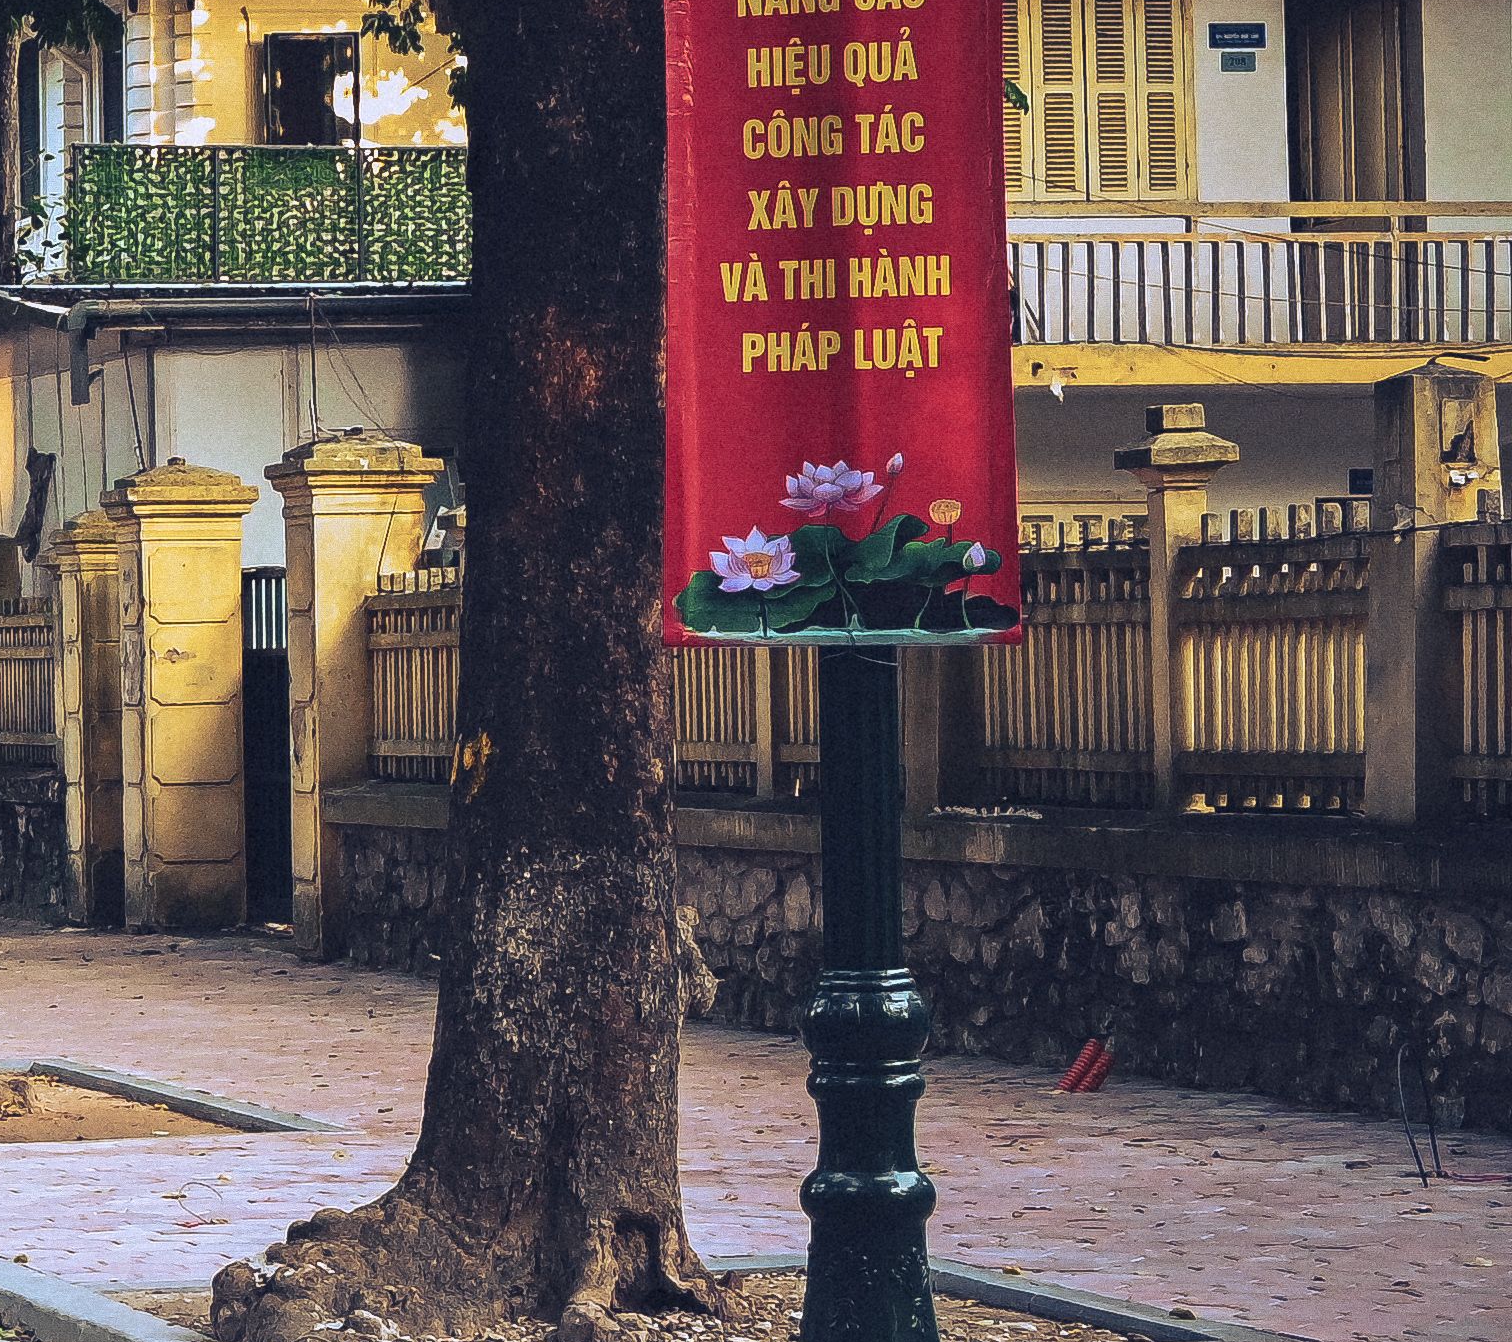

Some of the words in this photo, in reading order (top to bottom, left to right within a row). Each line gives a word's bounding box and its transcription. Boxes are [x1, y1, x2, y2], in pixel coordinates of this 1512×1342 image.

[747, 37, 831, 95] HIỆU
[843, 26, 919, 88] QUẢ
[742, 109, 843, 160] CÔNG
[854, 104, 925, 154] TÁC
[747, 180, 819, 231] XÂY
[831, 181, 933, 236] DỰNG
[719, 252, 769, 303] VÀ
[778, 258, 836, 301] THI
[849, 248, 951, 298] HÀNH
[742, 322, 841, 373] PHÁP
[854, 318, 944, 378] LUẬT
